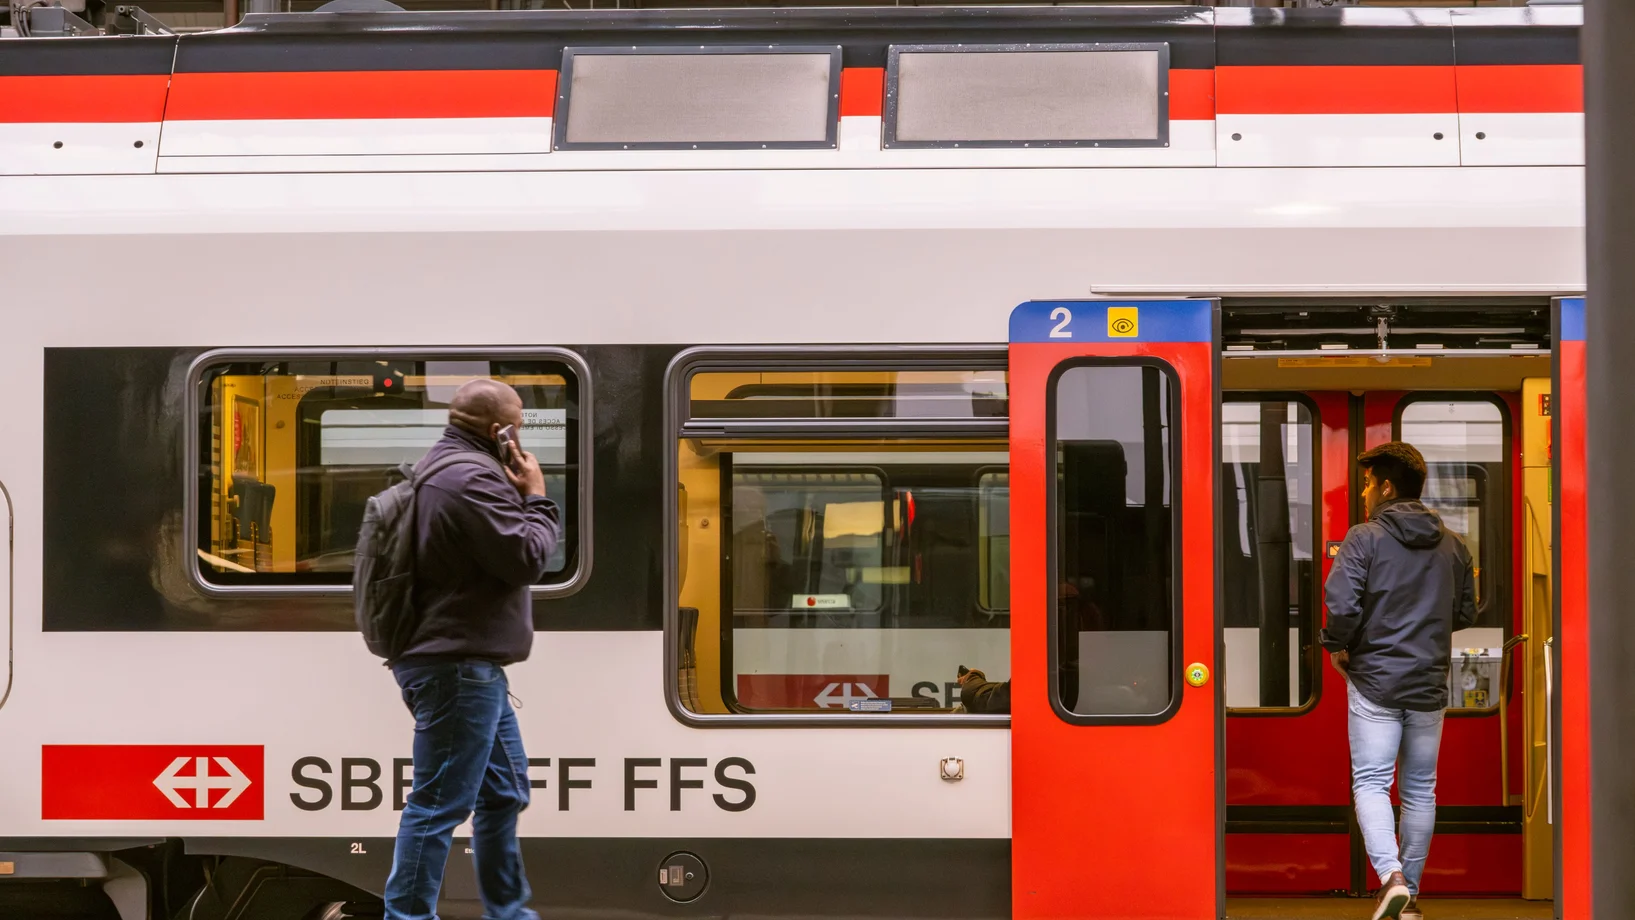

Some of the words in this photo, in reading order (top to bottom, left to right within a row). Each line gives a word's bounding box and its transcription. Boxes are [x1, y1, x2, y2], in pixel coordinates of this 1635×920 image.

[1049, 307, 1072, 338] 2
[527, 757, 596, 811] FF
[624, 756, 757, 812] FFS
[350, 842, 367, 854] 2L
